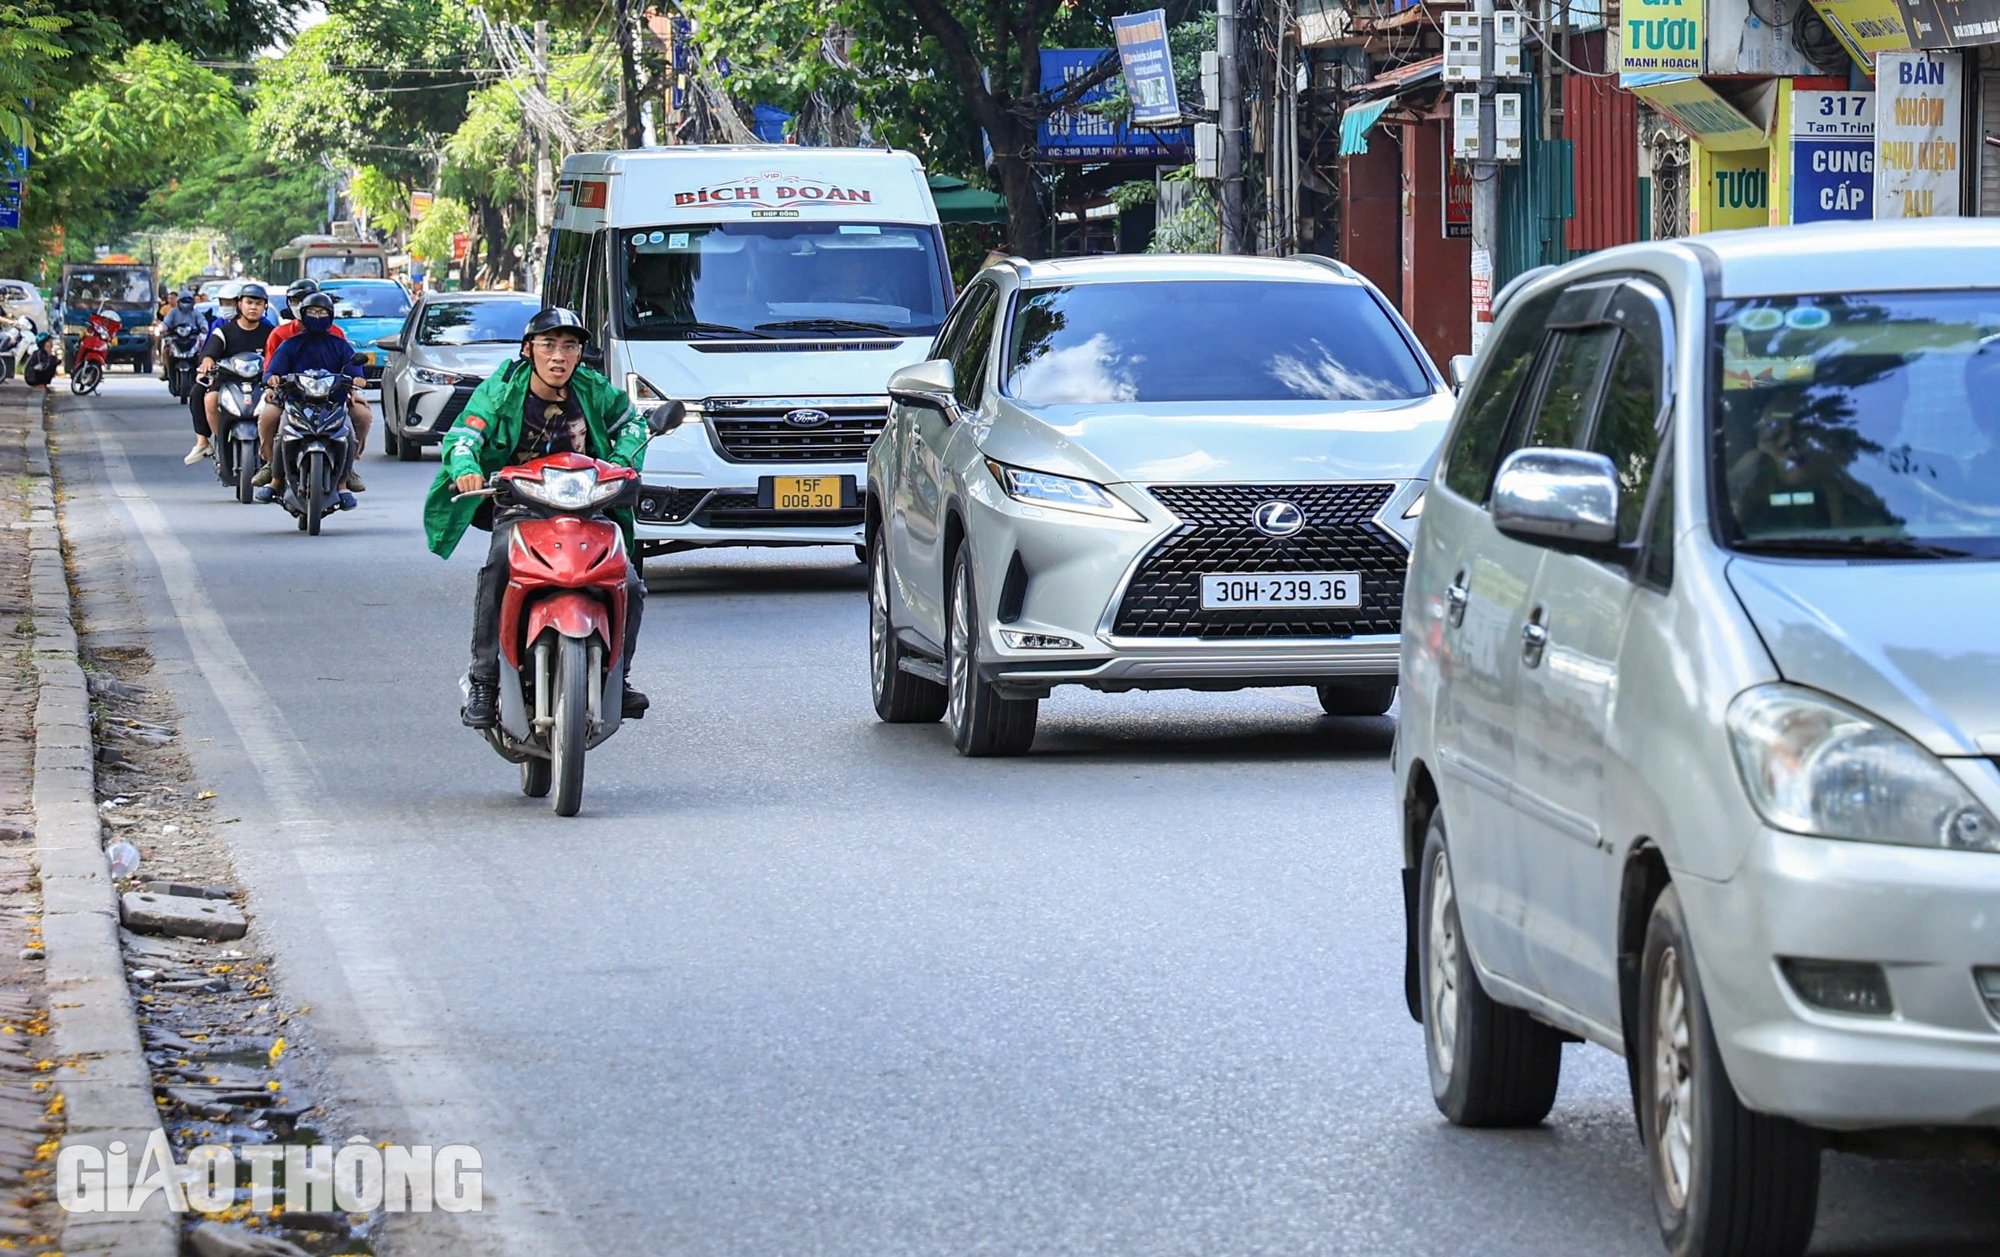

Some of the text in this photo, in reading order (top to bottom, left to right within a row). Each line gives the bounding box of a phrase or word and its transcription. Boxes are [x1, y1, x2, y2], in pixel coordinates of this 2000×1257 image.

[1628, 17, 1696, 50] TƯƠI
[1624, 58, 1699, 70] MẠNH HOẠCH
[1899, 61, 1944, 85] BÁN
[1819, 96, 1867, 116] 317
[1894, 92, 1944, 127] NHÔM
[1806, 121, 1837, 133] Tam
[1812, 150, 1873, 173] CUNG
[1881, 136, 1957, 178] PHỤ KIỆN
[674, 184, 872, 206] BÍCH ĐOÀN
[1715, 167, 1767, 209] TƯƠI
[1820, 180, 1865, 211] CẤP
[1903, 189, 1934, 217] ALU
[793, 412, 819, 423] Ford
[795, 479, 821, 492] 15F
[782, 494, 833, 508] 008.30
[1216, 580, 1347, 602] 30H-239.36
